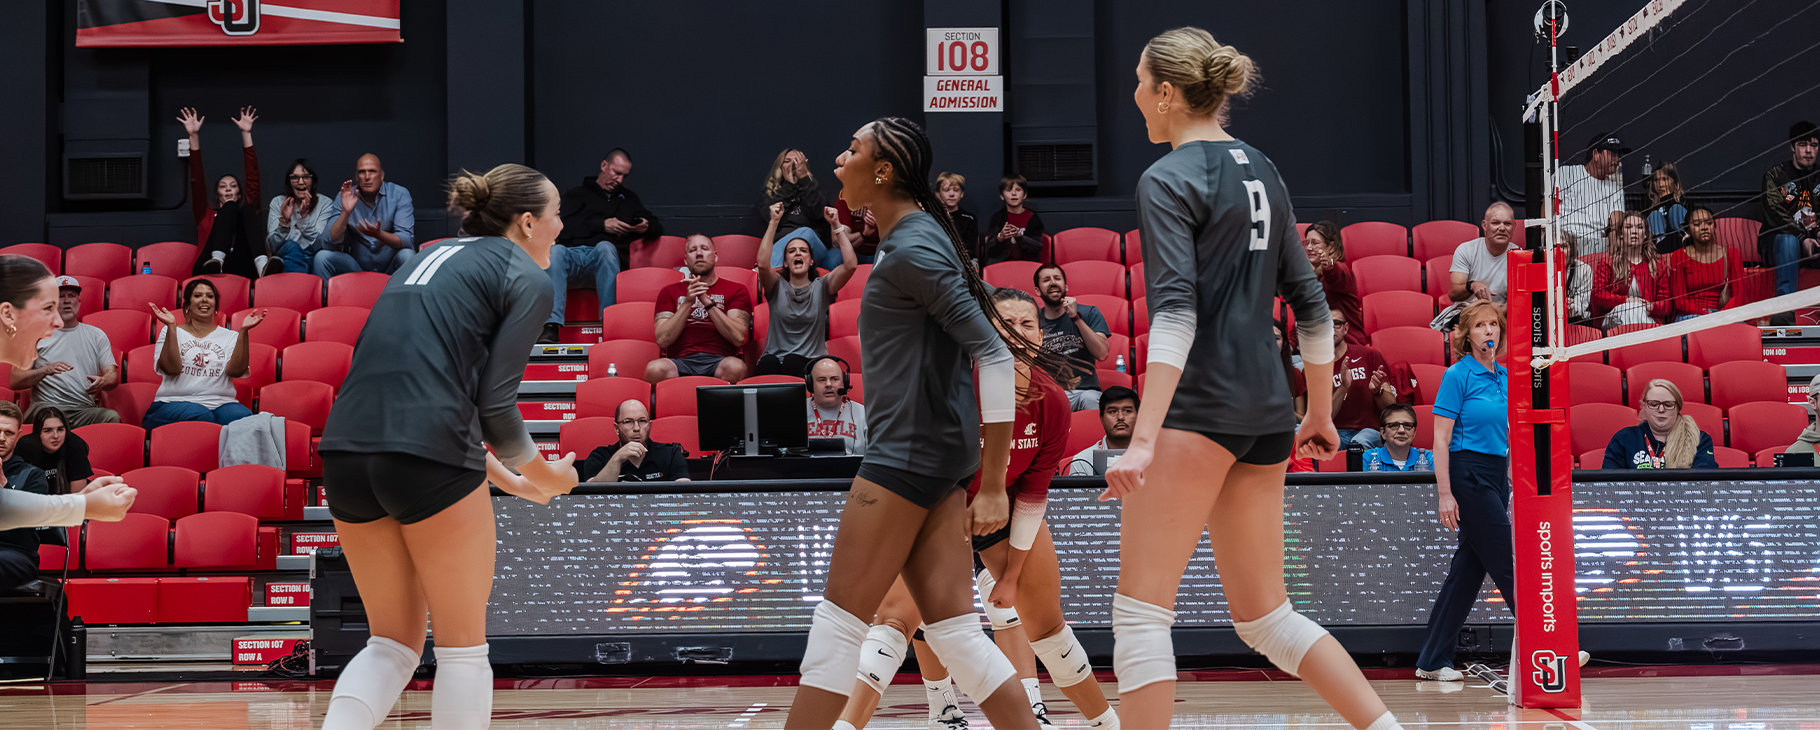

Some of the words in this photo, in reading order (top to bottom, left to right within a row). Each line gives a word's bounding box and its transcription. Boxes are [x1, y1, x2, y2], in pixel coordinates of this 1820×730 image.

[944, 32, 981, 41] SECTION
[938, 41, 989, 72] 108
[936, 79, 991, 92] GENERAL
[929, 96, 998, 108] ADMISSION
[1241, 179, 1271, 252] 9
[404, 245, 466, 286] 11
[1532, 306, 1543, 343] sports
[181, 365, 221, 377] COUGARS
[558, 364, 585, 372] SECTION
[1332, 366, 1367, 388] CGS
[1798, 386, 1810, 394] 108
[543, 402, 571, 410] SECTION
[807, 419, 857, 440] EATTLE
[536, 443, 557, 451] CTION
[1017, 437, 1039, 450] STATE
[295, 534, 326, 543] SECTION
[326, 534, 339, 543] 107
[1536, 520, 1555, 571] sports
[270, 584, 302, 593] SECTION
[302, 584, 310, 593] 10
[270, 596, 288, 605] ROW
[288, 596, 295, 604] B
[1539, 572, 1557, 633] imports
[238, 640, 270, 649] SECTION
[271, 640, 285, 649] 107
[238, 653, 256, 661] ROW
[256, 653, 263, 661] A
